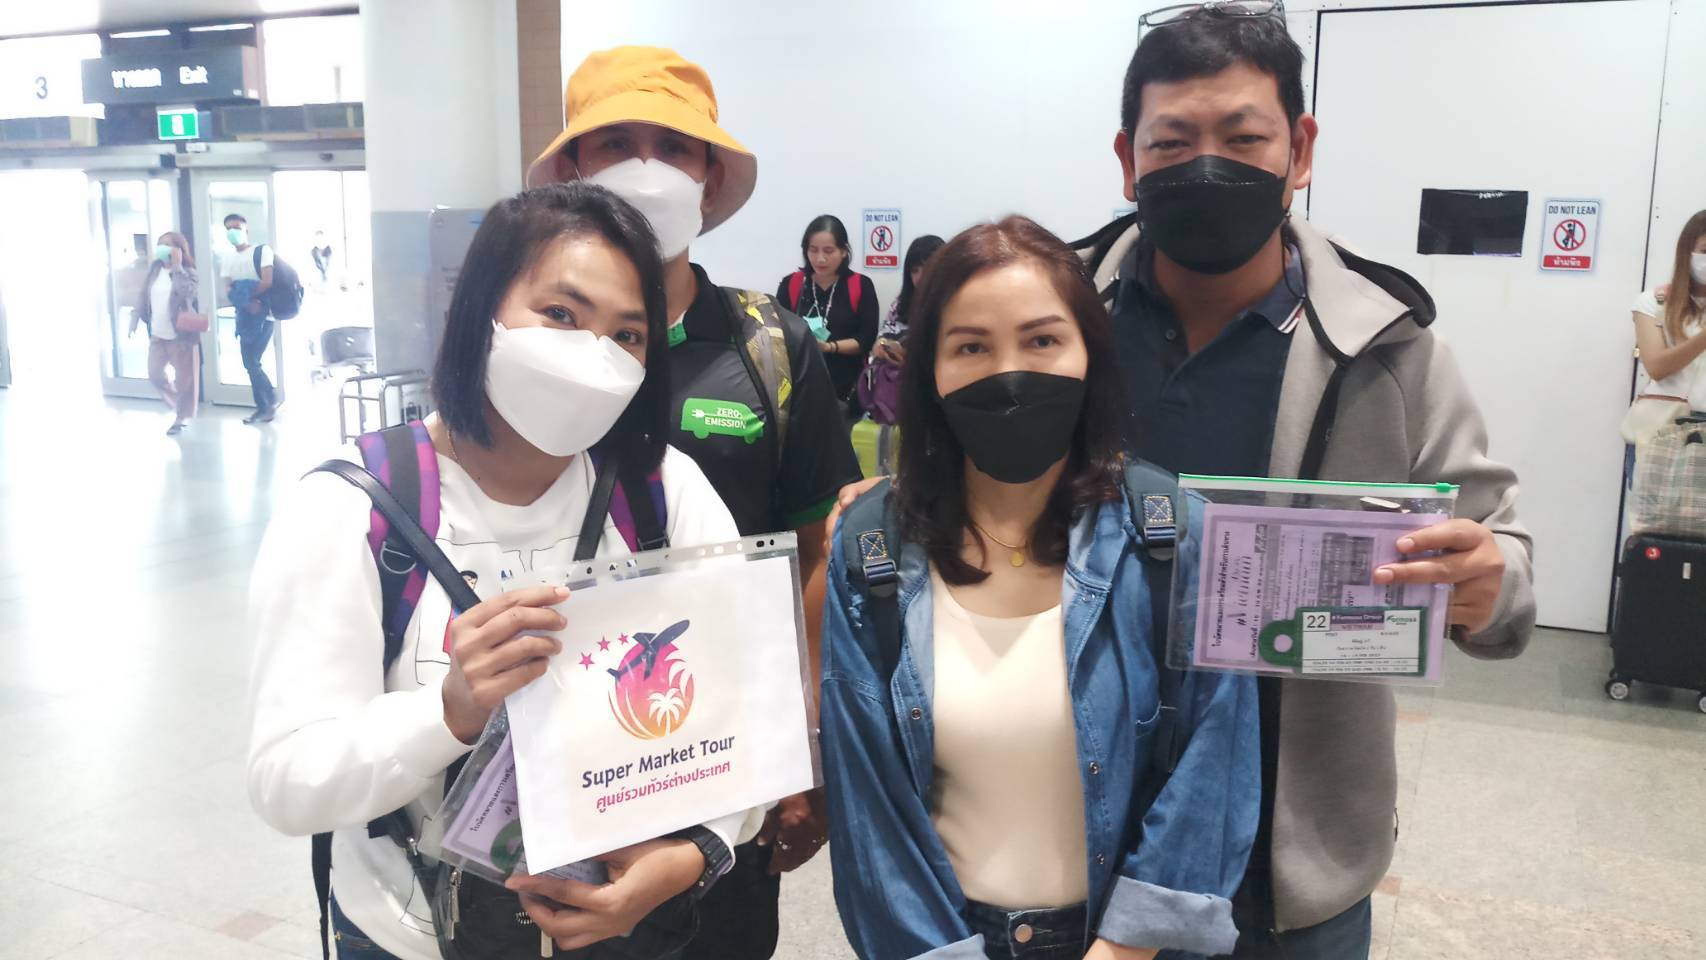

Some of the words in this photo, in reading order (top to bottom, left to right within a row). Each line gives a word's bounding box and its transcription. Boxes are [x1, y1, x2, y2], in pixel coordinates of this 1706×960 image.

[179, 66, 208, 84] Exit
[35, 76, 48, 99] 3
[1548, 206, 1559, 214] DO
[1560, 206, 1576, 214] NOT
[1577, 206, 1596, 215] LEAN
[866, 214, 873, 222] DO
[874, 214, 884, 222] NOT
[885, 214, 898, 222] LEAN
[716, 407, 741, 418] ZERO
[704, 417, 746, 429] EMISSION
[1307, 615, 1326, 628] 22
[582, 762, 633, 789] Super
[638, 744, 695, 774] Market
[700, 735, 736, 756] Tour
[596, 760, 731, 813] ศูนย์รวมทัวร์ต่างประเทศ
